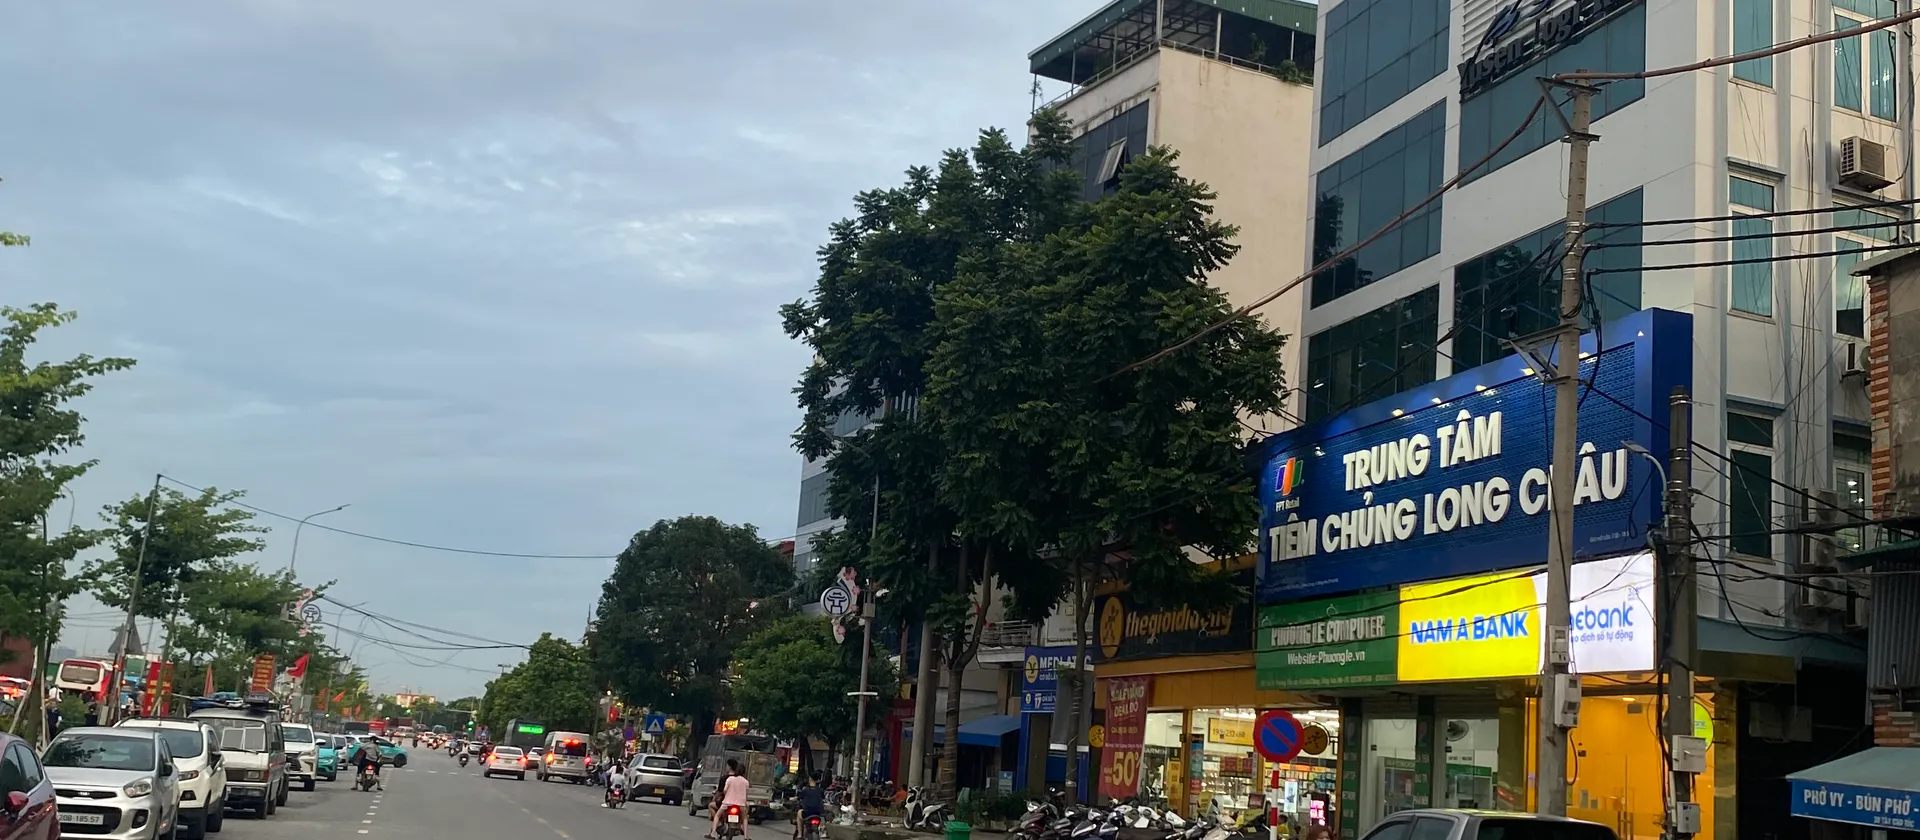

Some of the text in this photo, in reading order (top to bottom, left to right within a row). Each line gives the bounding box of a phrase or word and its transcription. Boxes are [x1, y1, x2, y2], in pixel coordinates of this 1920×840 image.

[1343, 409, 1502, 491] TRUNG TÂM
[1269, 442, 1628, 562] TIÊM CHỦNG LONG CÂU
[1276, 497, 1300, 512] FPT Retail
[1326, 615, 1385, 642] COMPUTER
[1411, 611, 1529, 644] NAM A BANK
[1614, 630, 1633, 641] động
[1804, 786, 1827, 805] PHỞ
[1830, 792, 1844, 807] VY
[1856, 793, 1881, 812] BÚN
[1885, 795, 1911, 815] PHỞ
